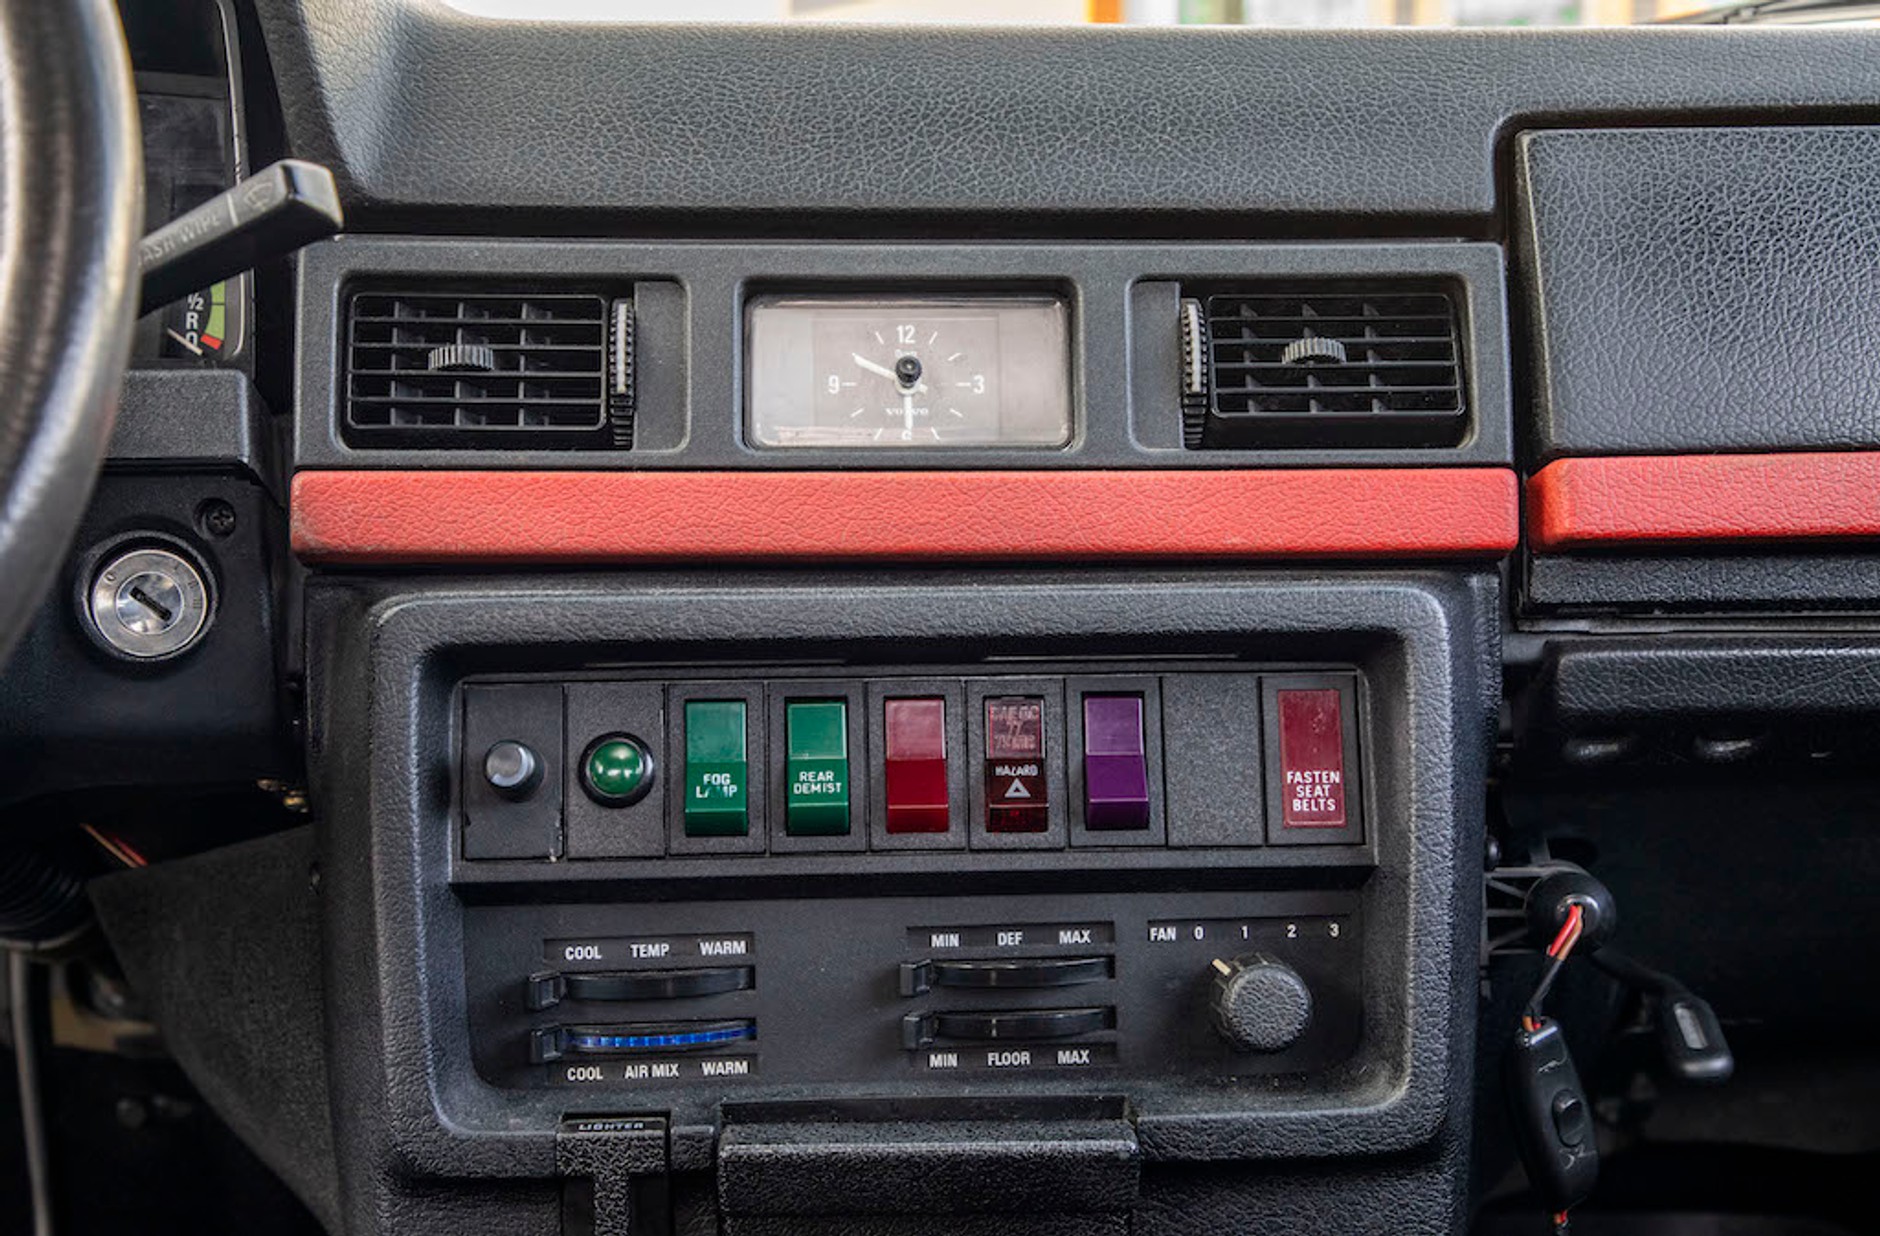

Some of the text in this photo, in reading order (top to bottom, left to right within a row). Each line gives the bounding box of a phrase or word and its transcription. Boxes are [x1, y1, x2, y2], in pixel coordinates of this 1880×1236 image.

[137, 241, 176, 267] ASH
[185, 312, 199, 330] R
[896, 325, 916, 344] 12
[828, 375, 840, 394] 9
[973, 375, 985, 394] 3
[703, 773, 731, 786] FOG
[799, 770, 834, 782] REAR
[1286, 770, 1340, 785] FASTEN
[793, 782, 842, 795] DEMIST
[1296, 784, 1331, 798] SEAT
[1292, 798, 1336, 812] BELTS
[931, 929, 1092, 948] MIN DEF MAX
[1150, 923, 1339, 942] FAN 0 1 2 3
[565, 940, 747, 961] COOL TEMP WARM
[929, 1049, 1090, 1068] MIN FLOOR MAX
[567, 1061, 749, 1082] COOL AIR MIX WARM
[578, 1121, 645, 1131] LIGHTER
